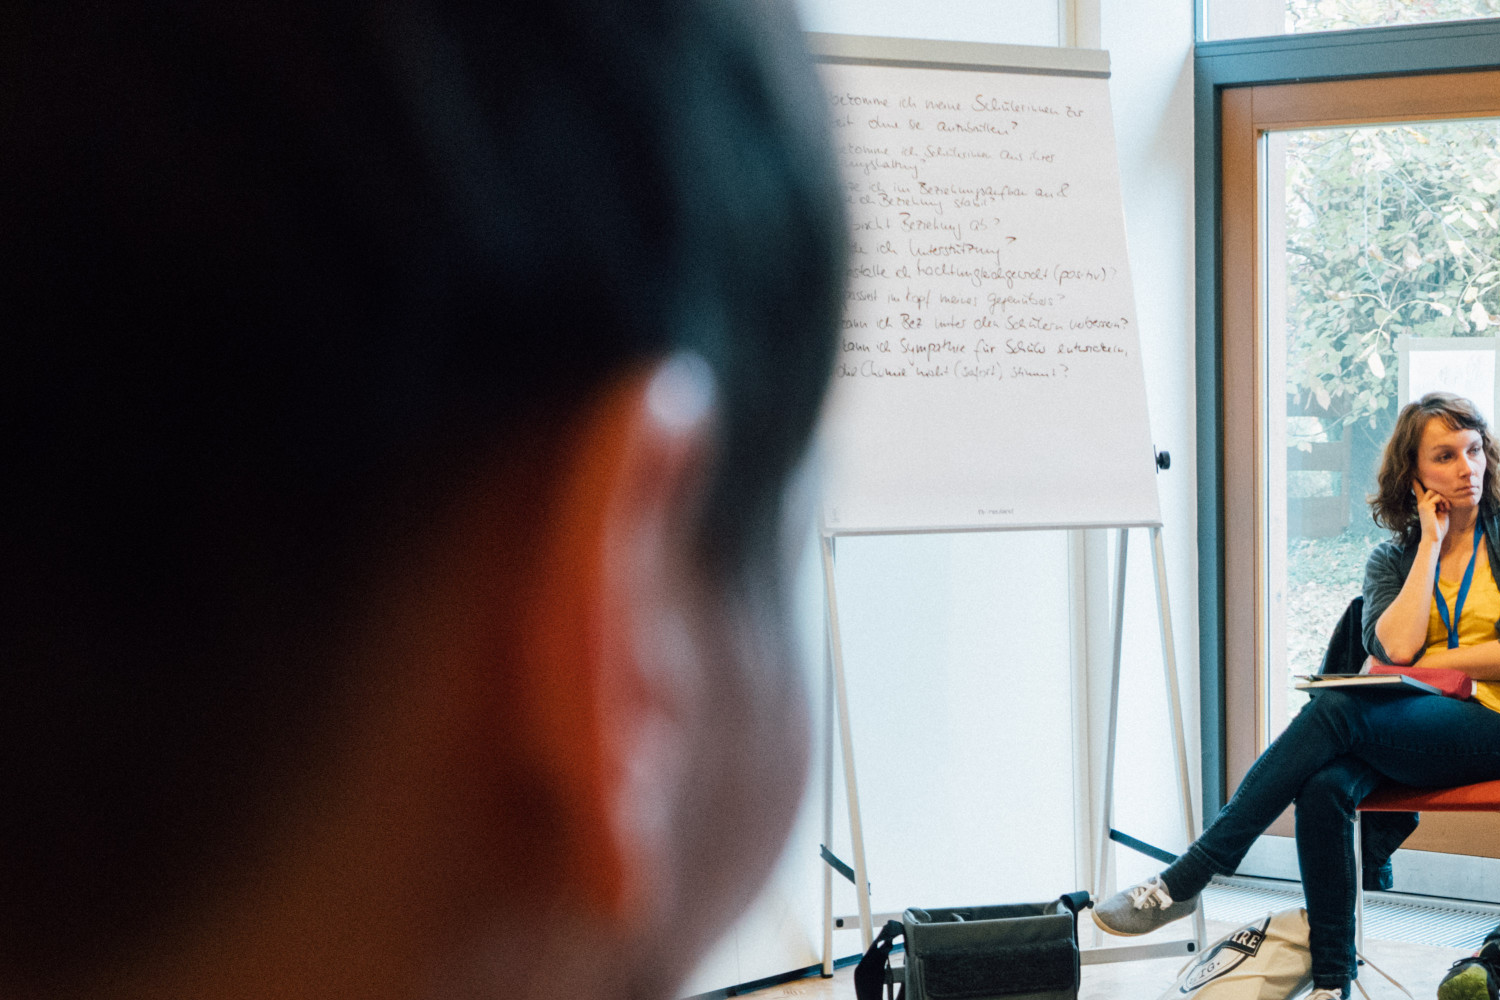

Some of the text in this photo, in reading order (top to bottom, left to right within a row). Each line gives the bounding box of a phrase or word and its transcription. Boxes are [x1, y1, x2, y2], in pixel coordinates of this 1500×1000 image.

[900, 96, 916, 108] ich
[925, 100, 960, 111] meine
[868, 115, 899, 129] ohne
[901, 146, 918, 157] ich
[1000, 150, 1023, 161] aus
[869, 183, 885, 193] ich
[878, 192, 943, 215] Beziehung
[899, 211, 961, 241] Beziehung
[876, 240, 898, 255] ich
[895, 265, 911, 279] ich
[940, 293, 977, 307] meines
[876, 317, 893, 330] ich
[935, 315, 966, 330] unter
[973, 315, 1000, 330] den
[1005, 315, 1063, 330] Schülern
[842, 338, 870, 353] kann
[876, 340, 892, 353] ich
[900, 338, 966, 366] Sympathie
[973, 338, 995, 362] für
[916, 365, 949, 377] nicht
[1231, 930, 1260, 949] IRE
